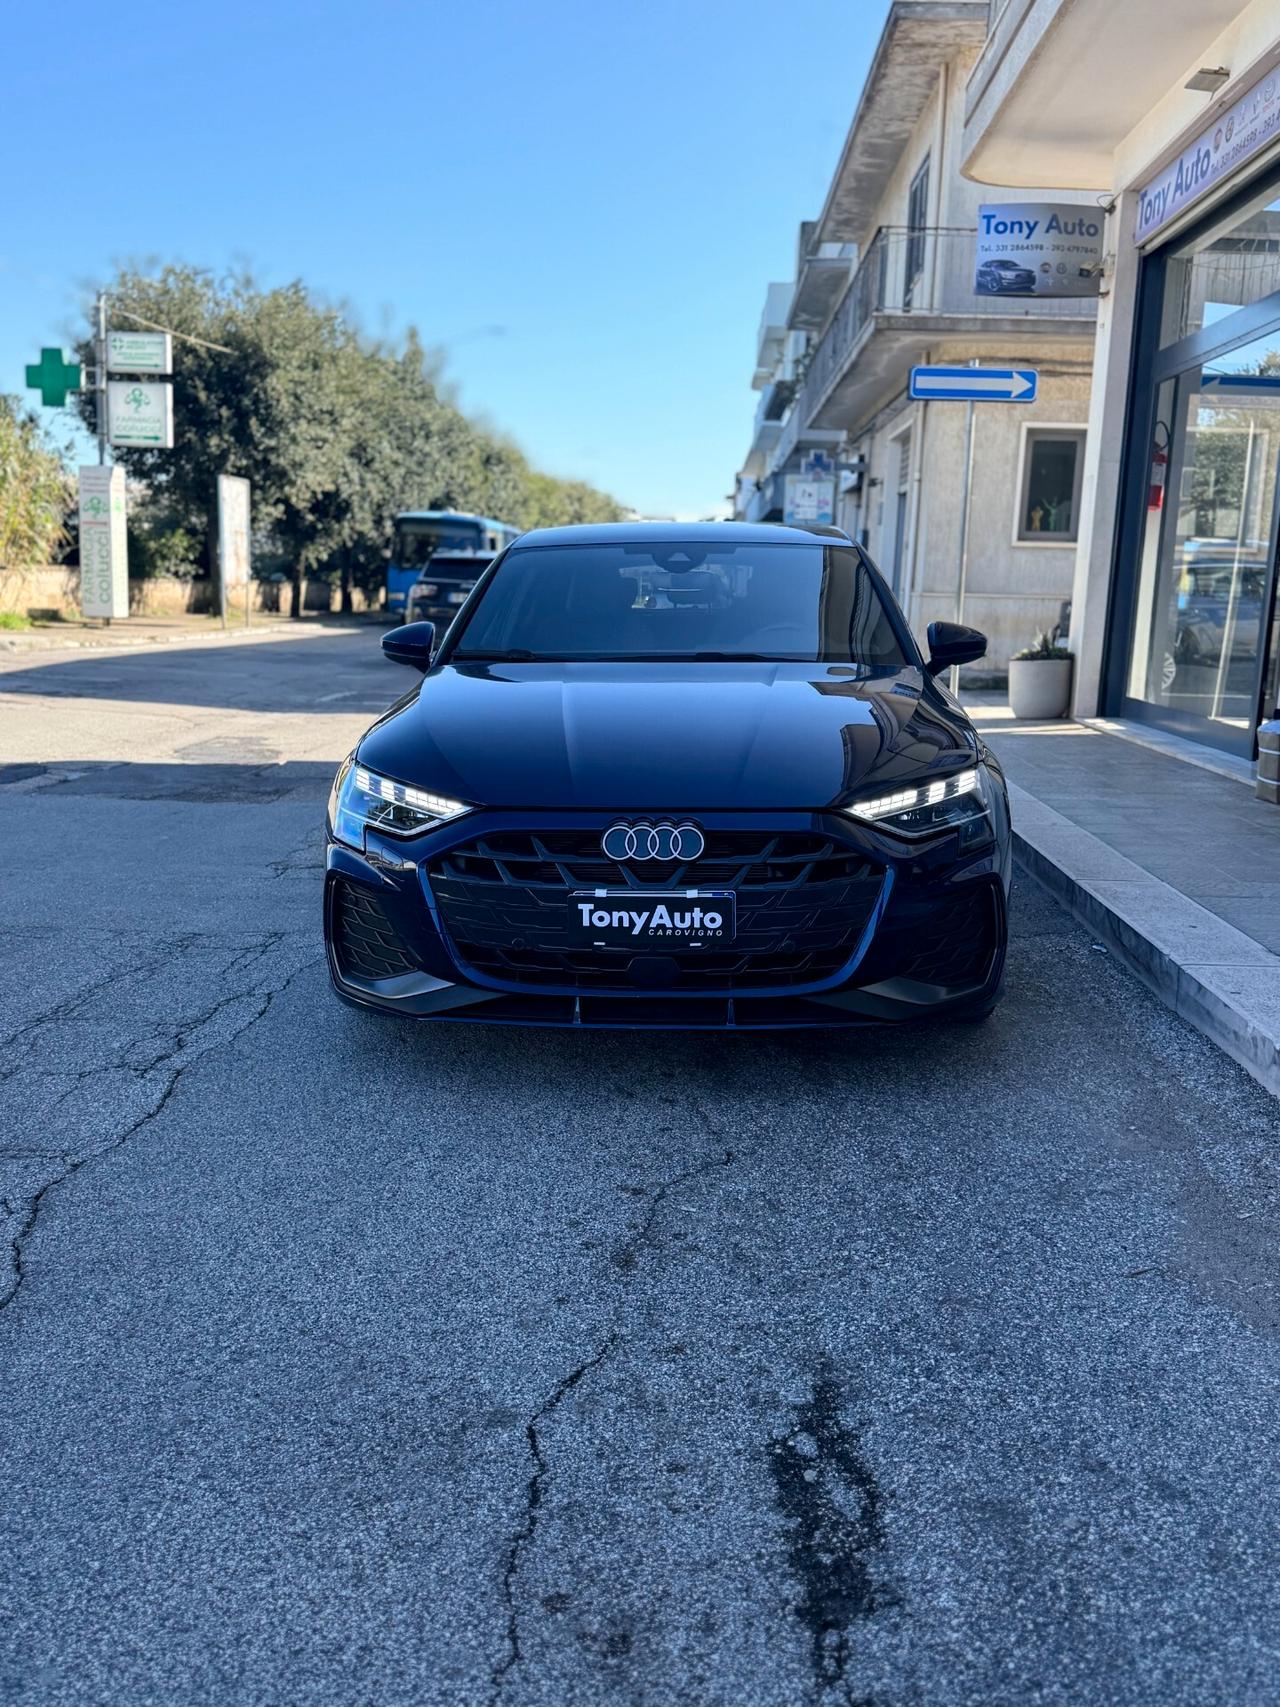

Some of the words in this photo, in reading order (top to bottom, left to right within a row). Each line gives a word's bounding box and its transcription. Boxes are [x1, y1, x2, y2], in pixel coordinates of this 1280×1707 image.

[1138, 189, 1171, 231] Tony
[1172, 146, 1211, 204] Auto
[981, 214, 1040, 240] Tony
[1044, 213, 1099, 237] Auto
[995, 244, 1008, 252] 331
[1010, 244, 1044, 252] 2864598
[82, 526, 94, 605] FARMACIA
[94, 530, 110, 604] colucci
[577, 903, 723, 935] TonyAuto
[648, 929, 723, 937] CAROVIGNO
